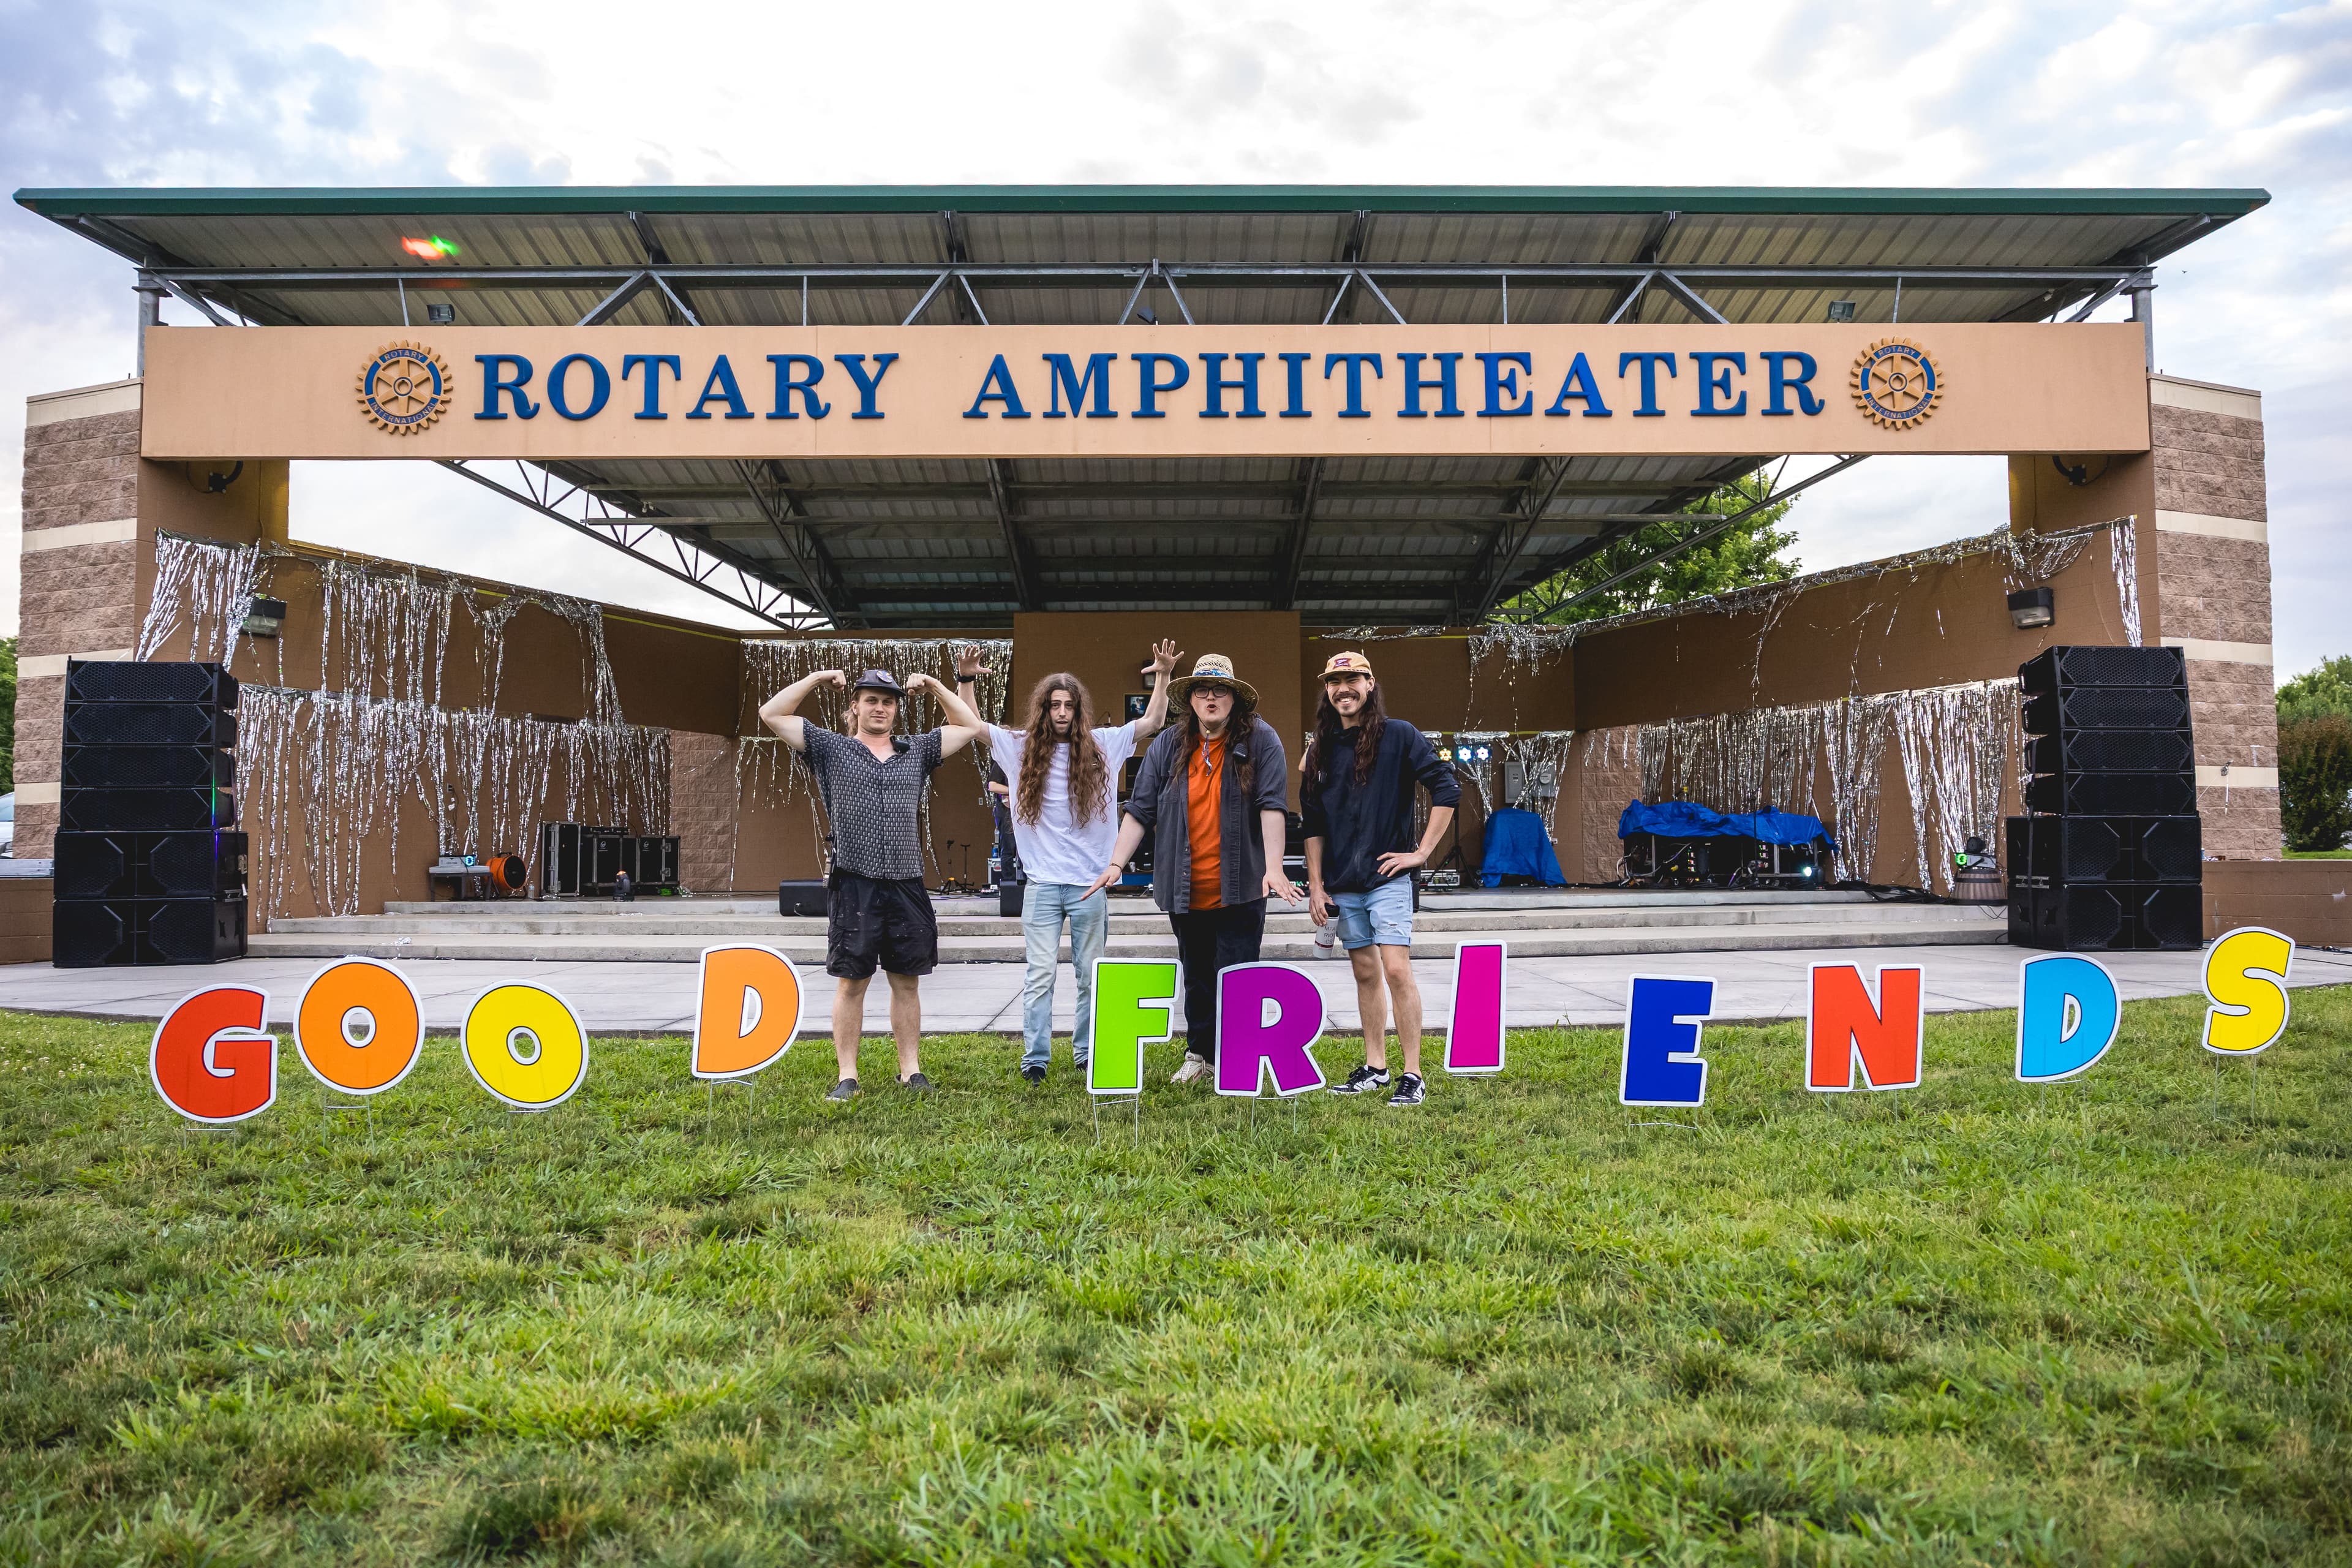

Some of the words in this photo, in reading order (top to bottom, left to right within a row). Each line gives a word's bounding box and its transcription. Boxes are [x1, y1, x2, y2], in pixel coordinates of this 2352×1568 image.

[384, 350, 424, 361] ROTARY
[1878, 345, 1916, 357] ROTARY
[475, 353, 899, 420] ROTARY
[963, 352, 1825, 418] AMPHITHEATER
[370, 401, 437, 424] INTERNATIONAL
[1866, 397, 1931, 419] INTERNATIONAL
[150, 943, 804, 1123] GOOD
[1087, 927, 2294, 1106] FRIENDS
